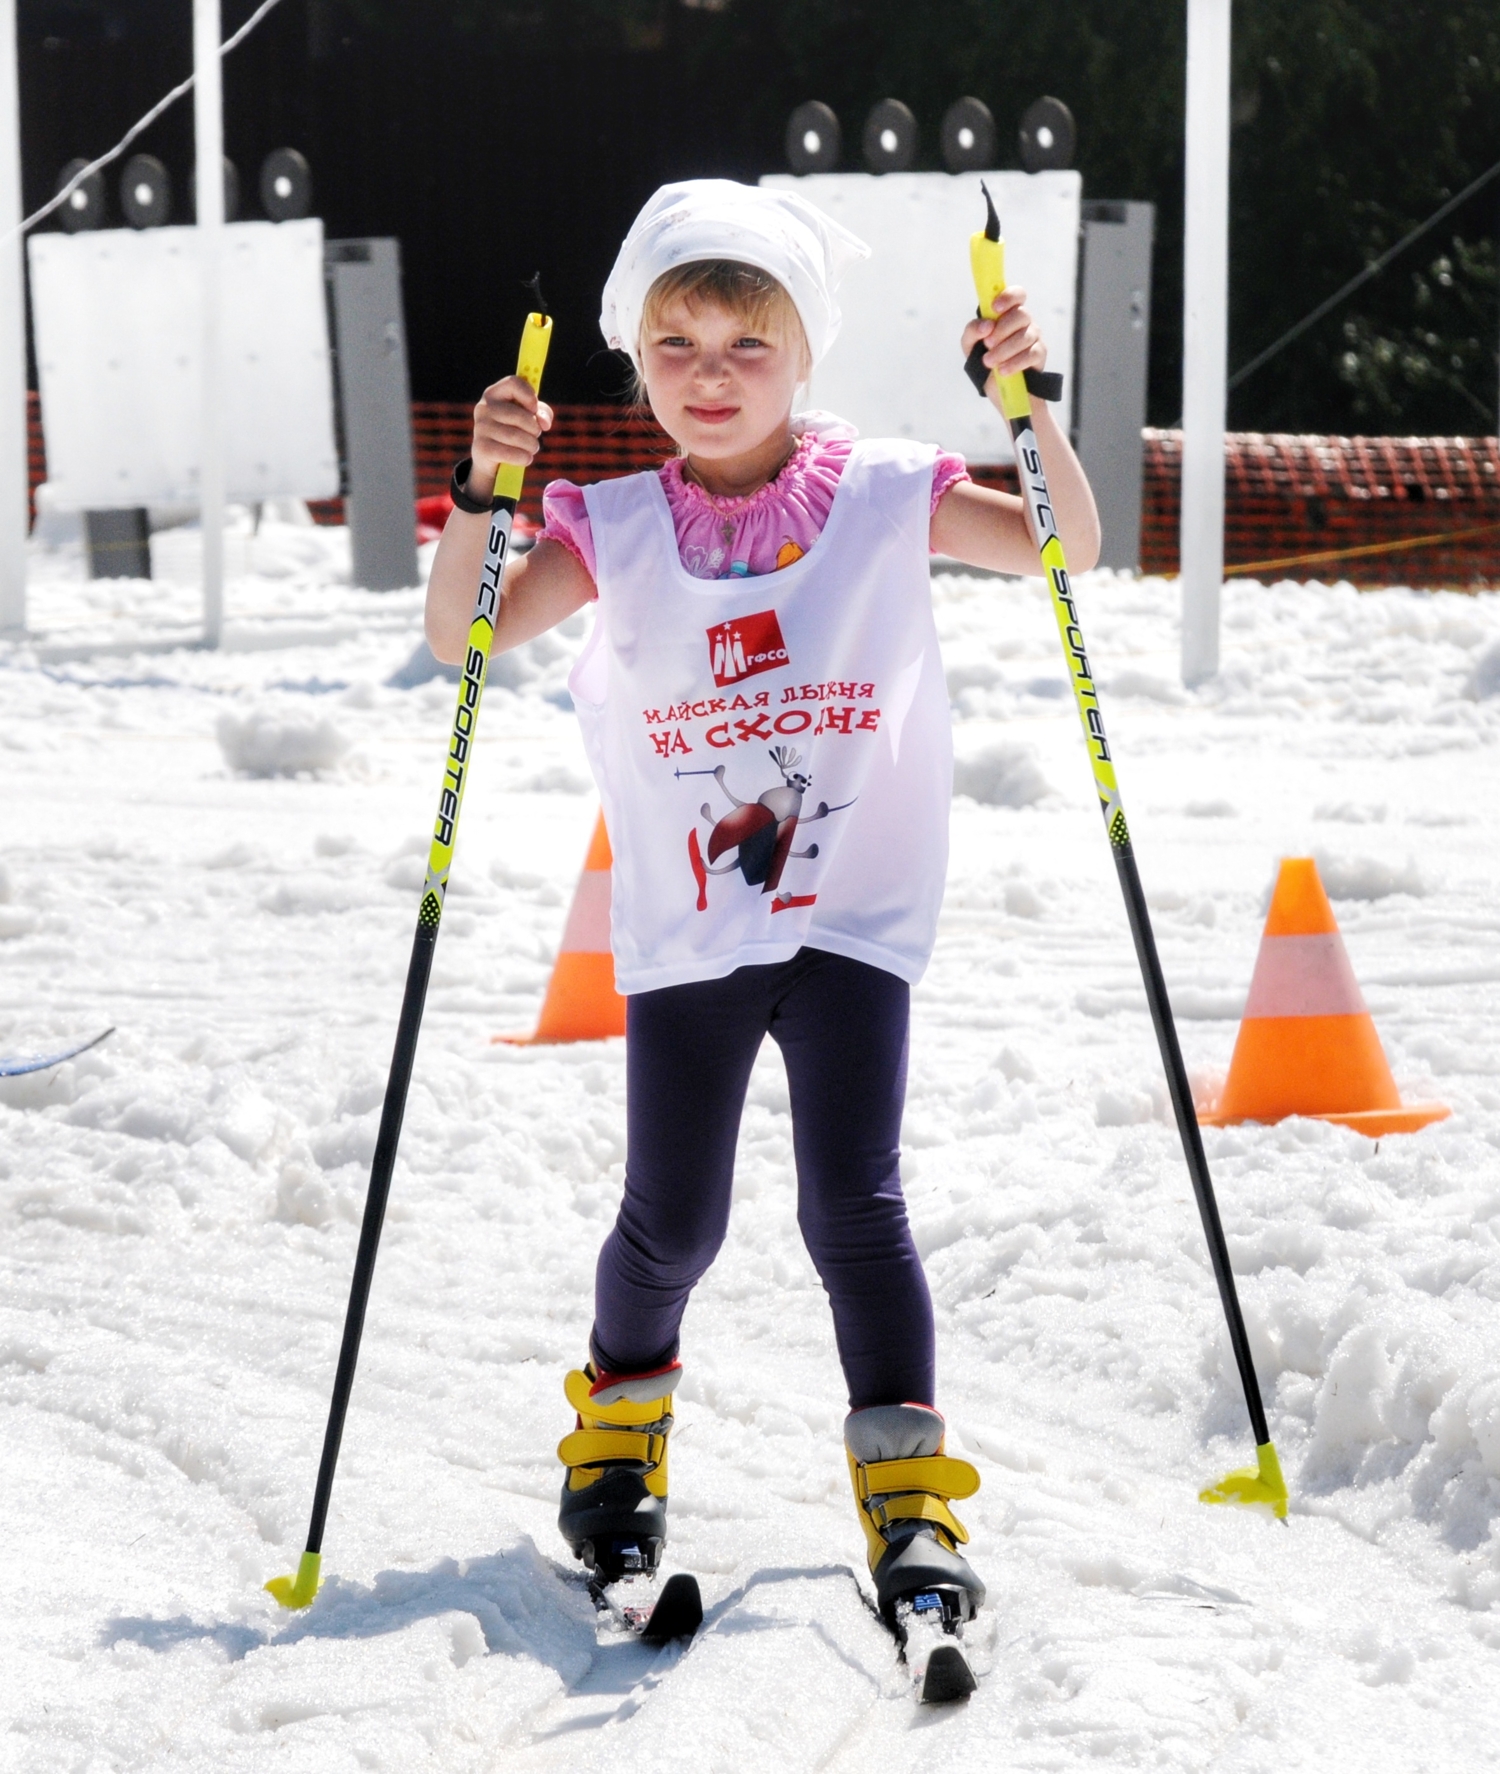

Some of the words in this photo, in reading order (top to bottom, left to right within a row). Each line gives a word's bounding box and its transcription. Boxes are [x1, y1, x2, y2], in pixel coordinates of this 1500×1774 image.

[1022, 447, 1056, 532] STC
[476, 524, 506, 617] STC
[643, 691, 769, 724] МАЙСКАЯ
[1051, 567, 1112, 763] SPORTER
[434, 645, 484, 847] SPORTER
[649, 728, 693, 758] НА
